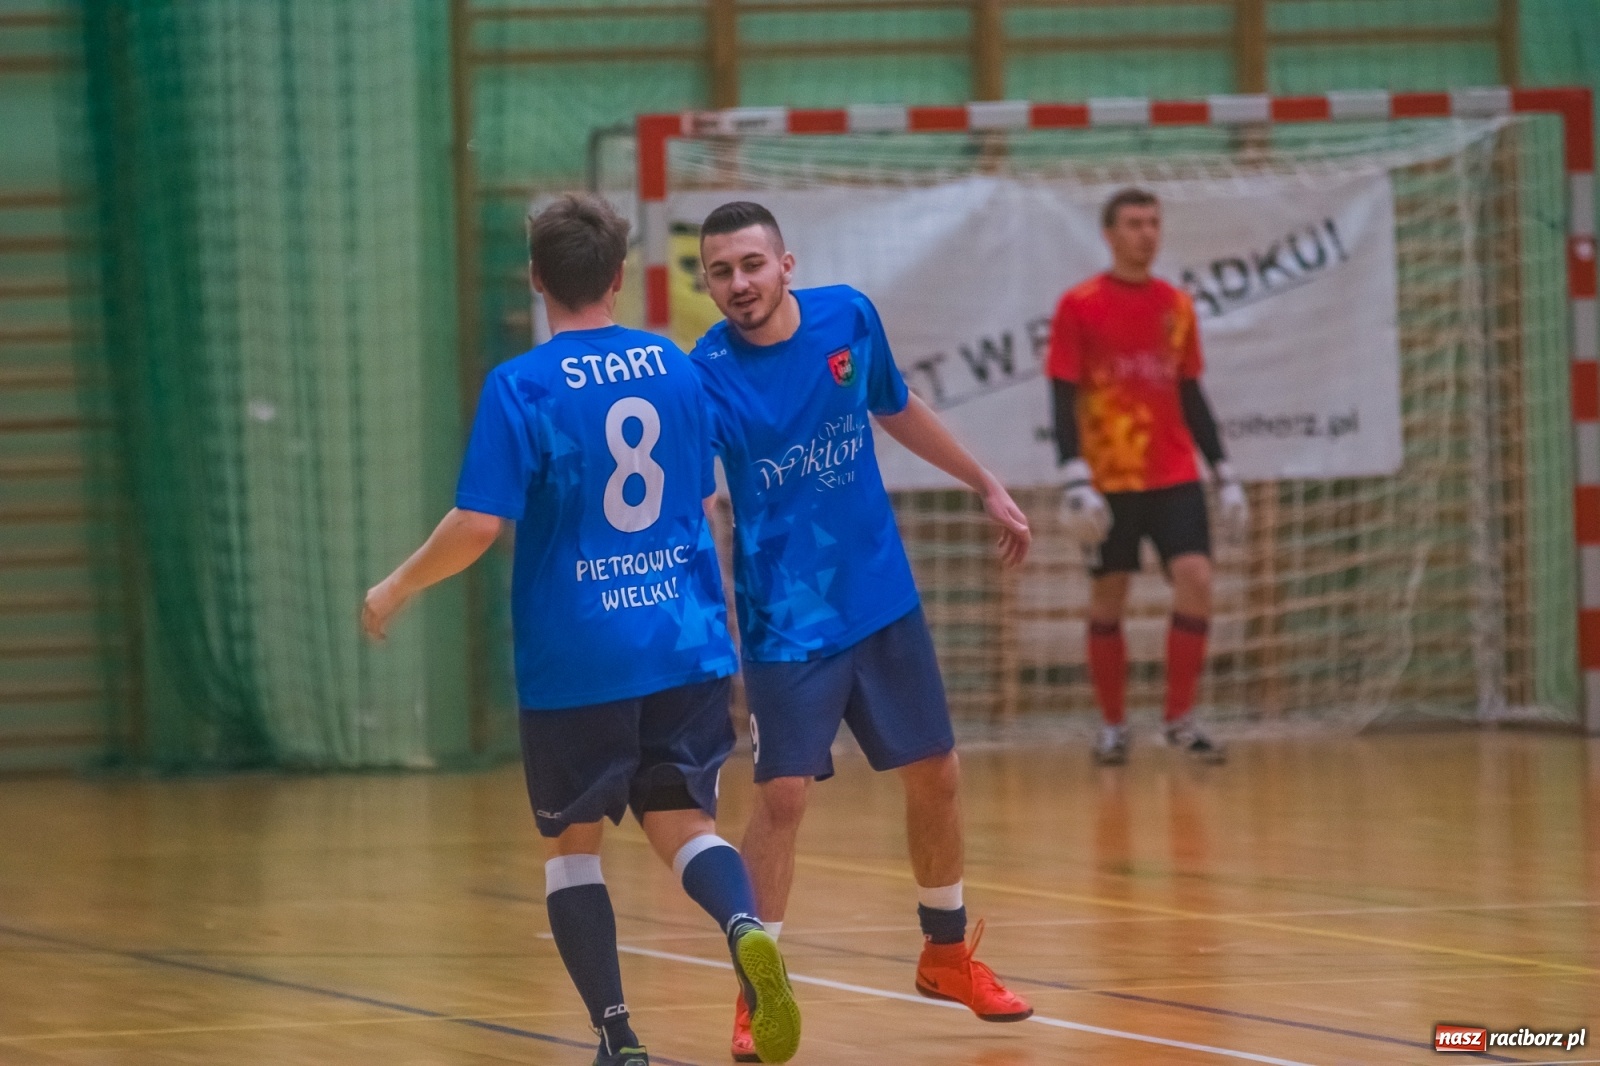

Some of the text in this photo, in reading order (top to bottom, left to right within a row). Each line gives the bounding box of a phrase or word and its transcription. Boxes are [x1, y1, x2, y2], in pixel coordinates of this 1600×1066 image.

[561, 345, 668, 389] START
[957, 328, 1013, 384] W
[603, 396, 665, 533] 8
